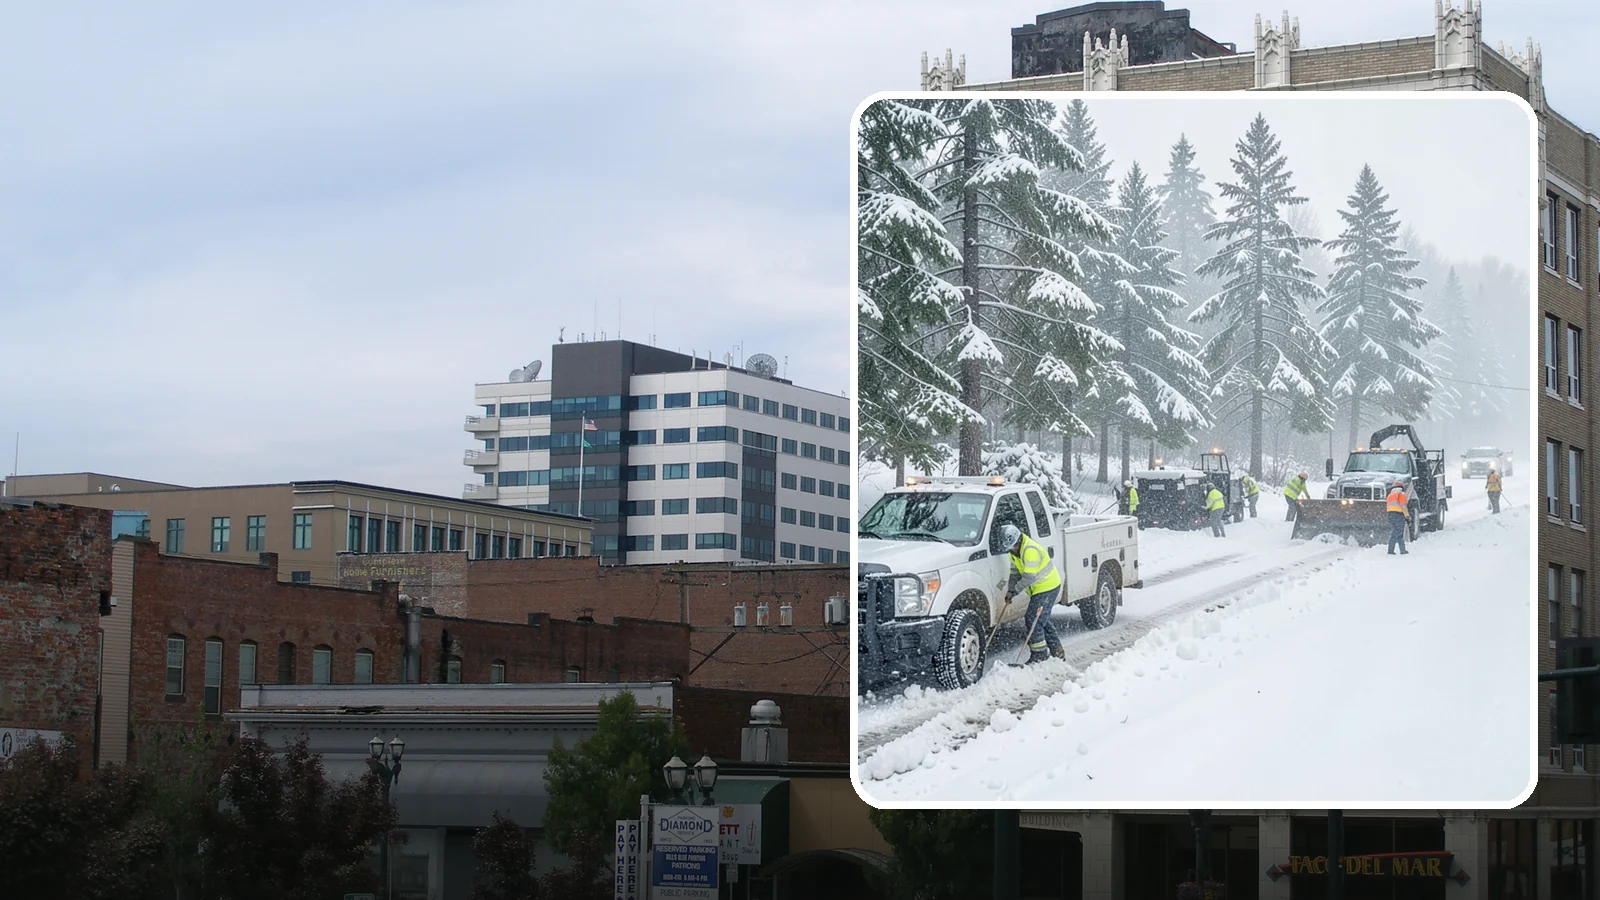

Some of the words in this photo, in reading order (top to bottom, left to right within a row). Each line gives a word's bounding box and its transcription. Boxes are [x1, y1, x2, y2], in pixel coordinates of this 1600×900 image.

[343, 568, 367, 577] Home
[370, 566, 427, 576] Furnishers
[660, 818, 714, 833] DIAMOND
[1022, 815, 1069, 828] BUILDING
[617, 825, 625, 852] PAY
[628, 824, 637, 852] PAY
[656, 845, 688, 853] RESERVED
[689, 846, 716, 854] PARKING
[722, 851, 739, 862] Soup
[672, 862, 701, 870] PATRONS
[1288, 855, 1329, 874] TAC
[1346, 856, 1384, 875] DEL
[1391, 857, 1442, 877] MAR
[616, 856, 625, 894] HERE
[627, 855, 637, 894] HERE
[661, 888, 682, 897] PUBLIC
[684, 889, 710, 898] PARKING
